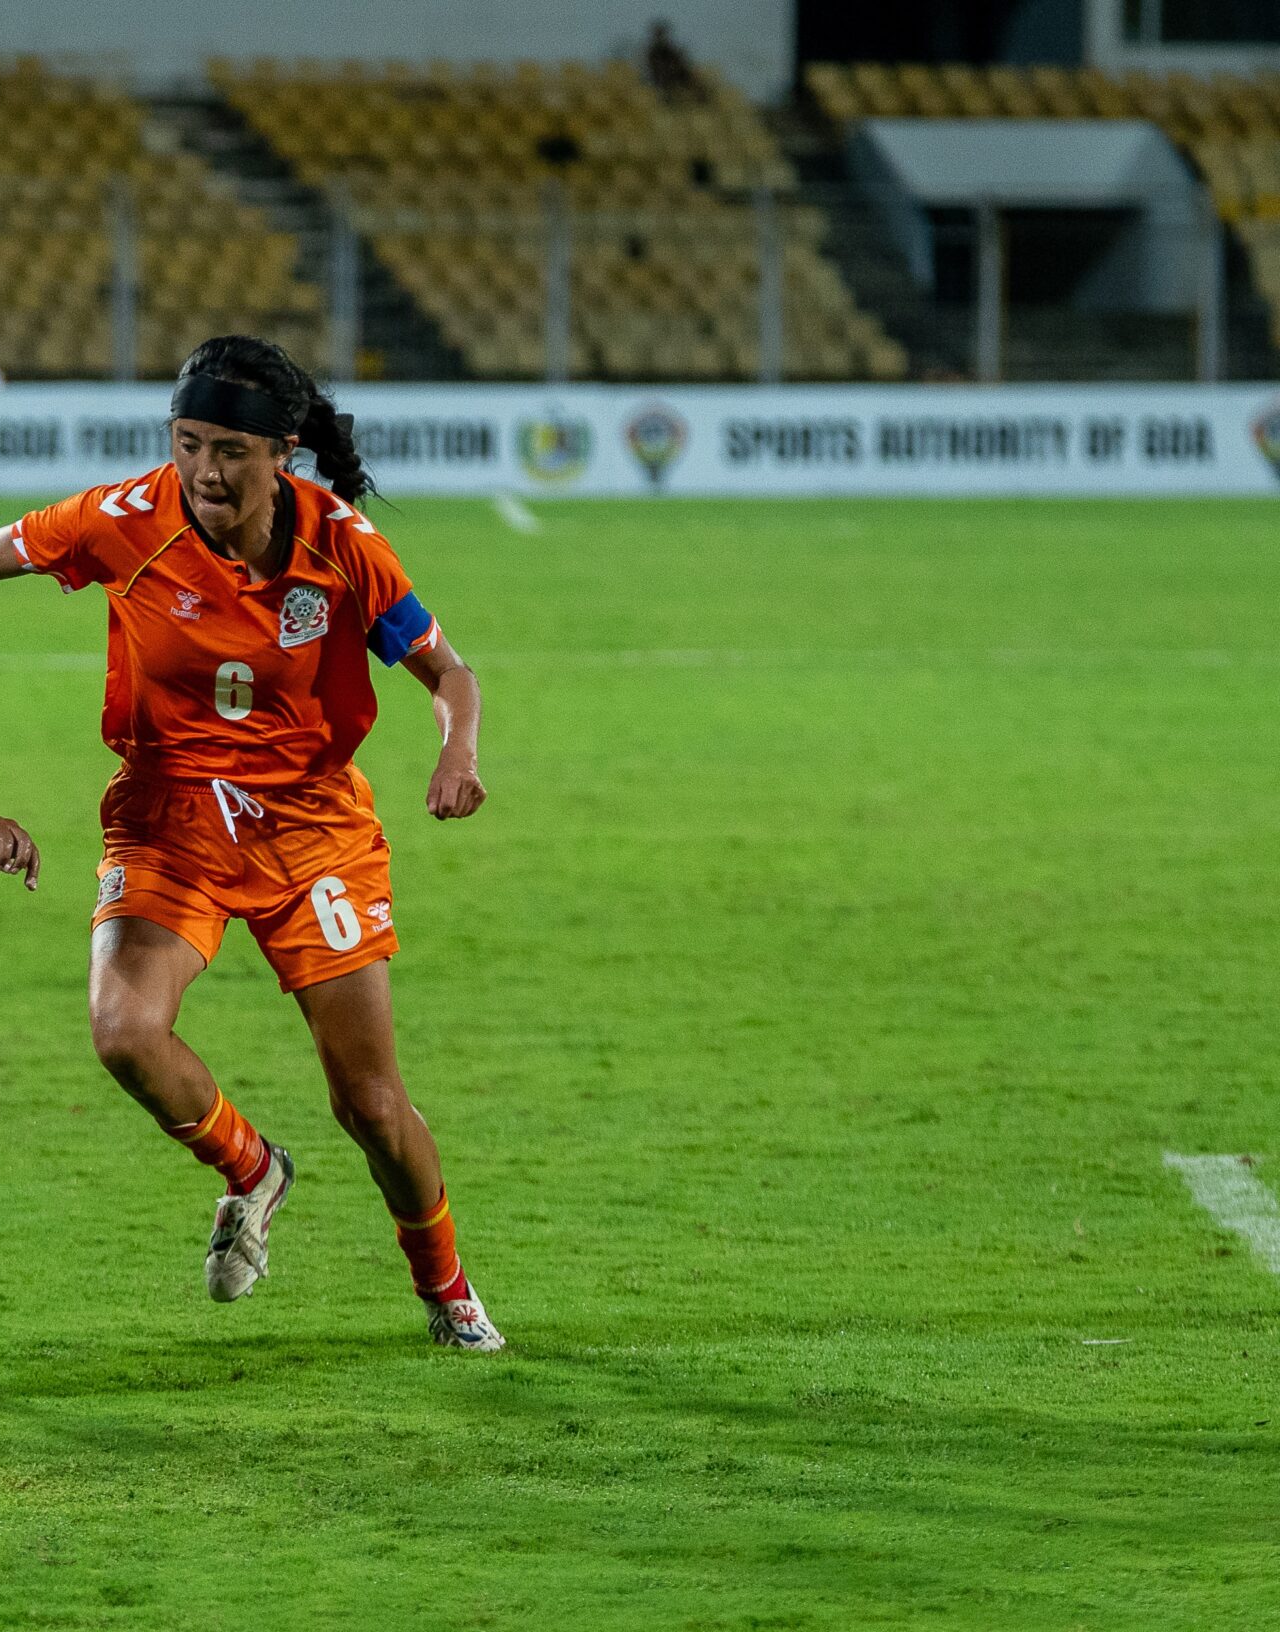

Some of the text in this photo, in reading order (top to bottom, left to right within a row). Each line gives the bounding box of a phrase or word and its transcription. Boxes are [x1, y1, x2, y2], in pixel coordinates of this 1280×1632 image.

[722, 417, 860, 462] SPORTS
[877, 417, 1069, 462] AUTHORITY
[1085, 417, 1125, 462] OF
[287, 588, 321, 604] BHUTAN
[215, 661, 254, 720] 6
[310, 876, 362, 952] 6
